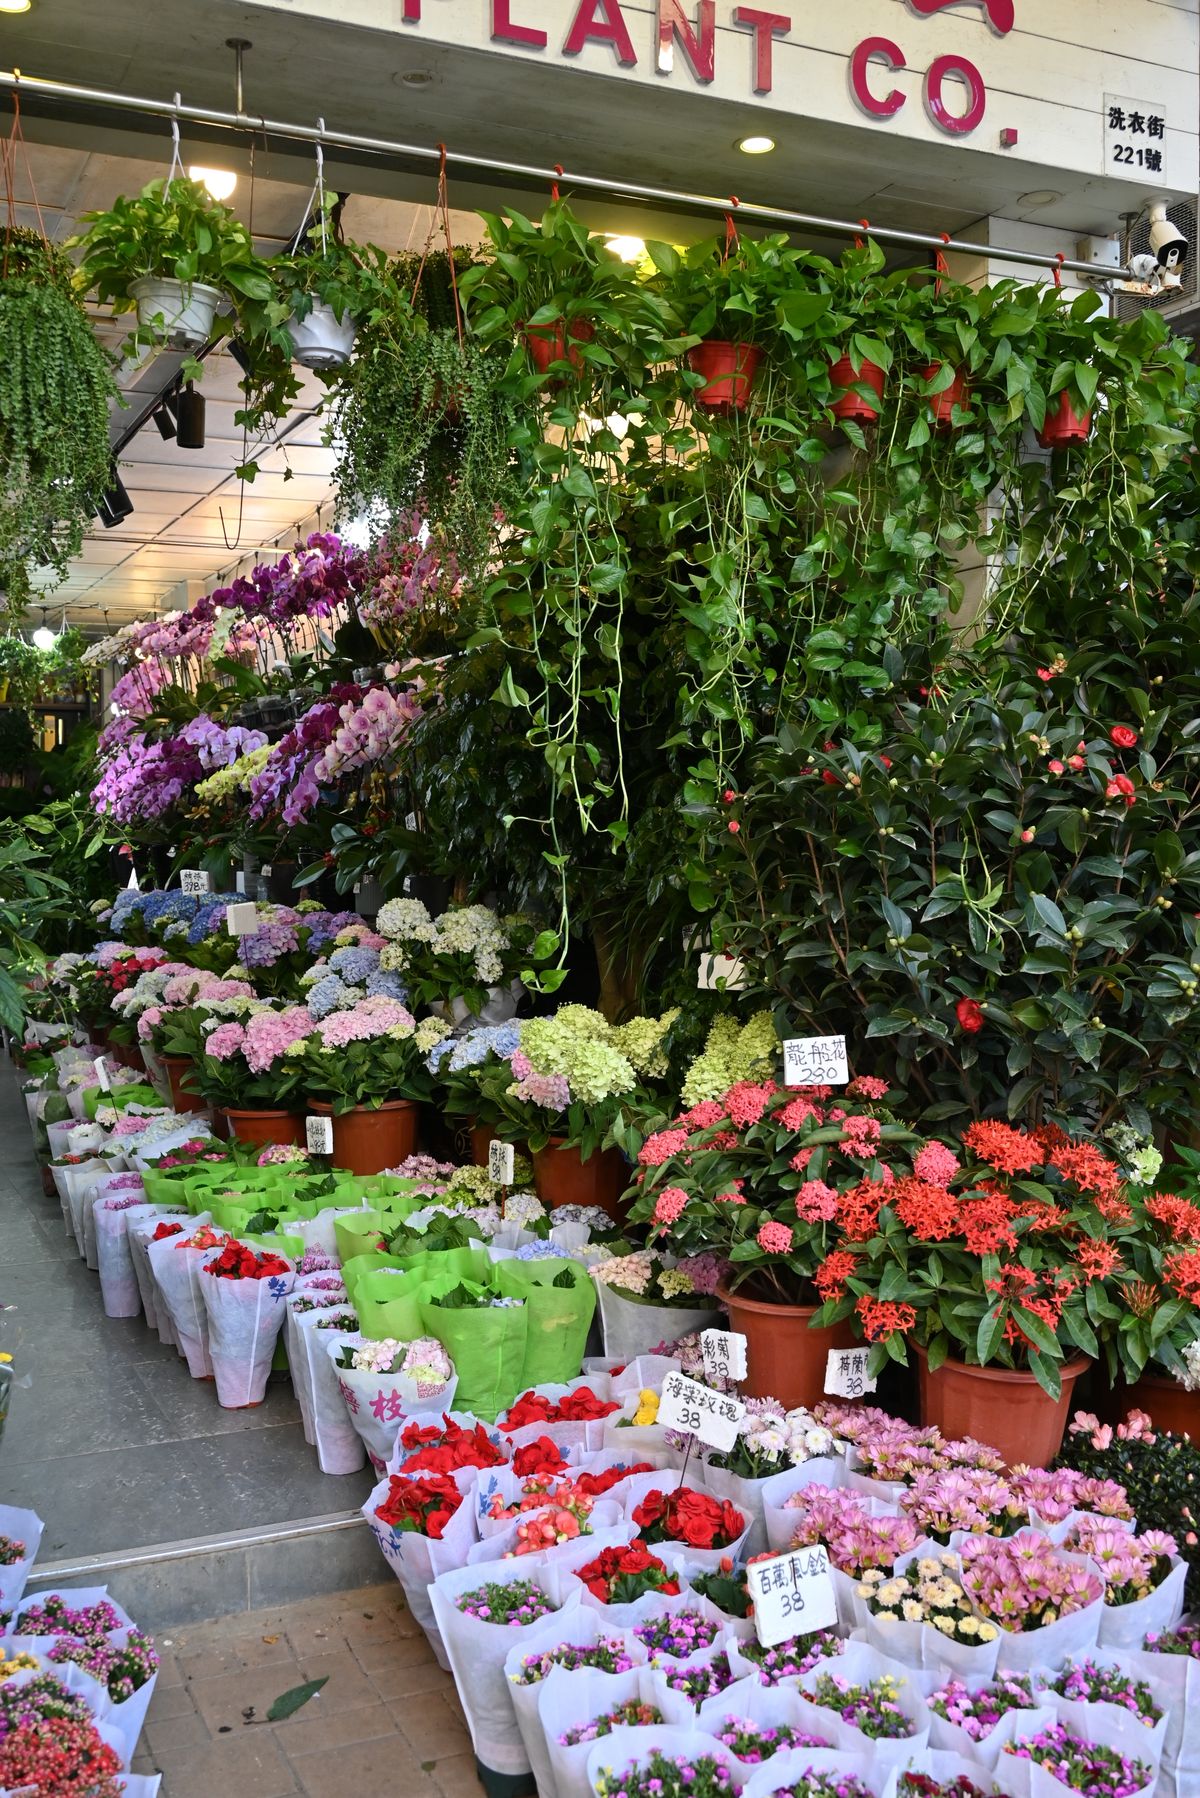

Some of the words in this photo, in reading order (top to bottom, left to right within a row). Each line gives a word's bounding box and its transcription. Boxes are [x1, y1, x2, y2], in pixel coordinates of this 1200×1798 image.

[401, 0, 791, 95] LANT
[848, 36, 1017, 147] CO.
[1108, 106, 1165, 140] 洗衣街
[1113, 143, 1163, 173] 221號
[709, 1360, 730, 1378] 38
[837, 1352, 869, 1377] 荷蘭
[845, 1377, 864, 1395] 38
[677, 1407, 701, 1429] 38
[781, 1591, 805, 1618] 38
